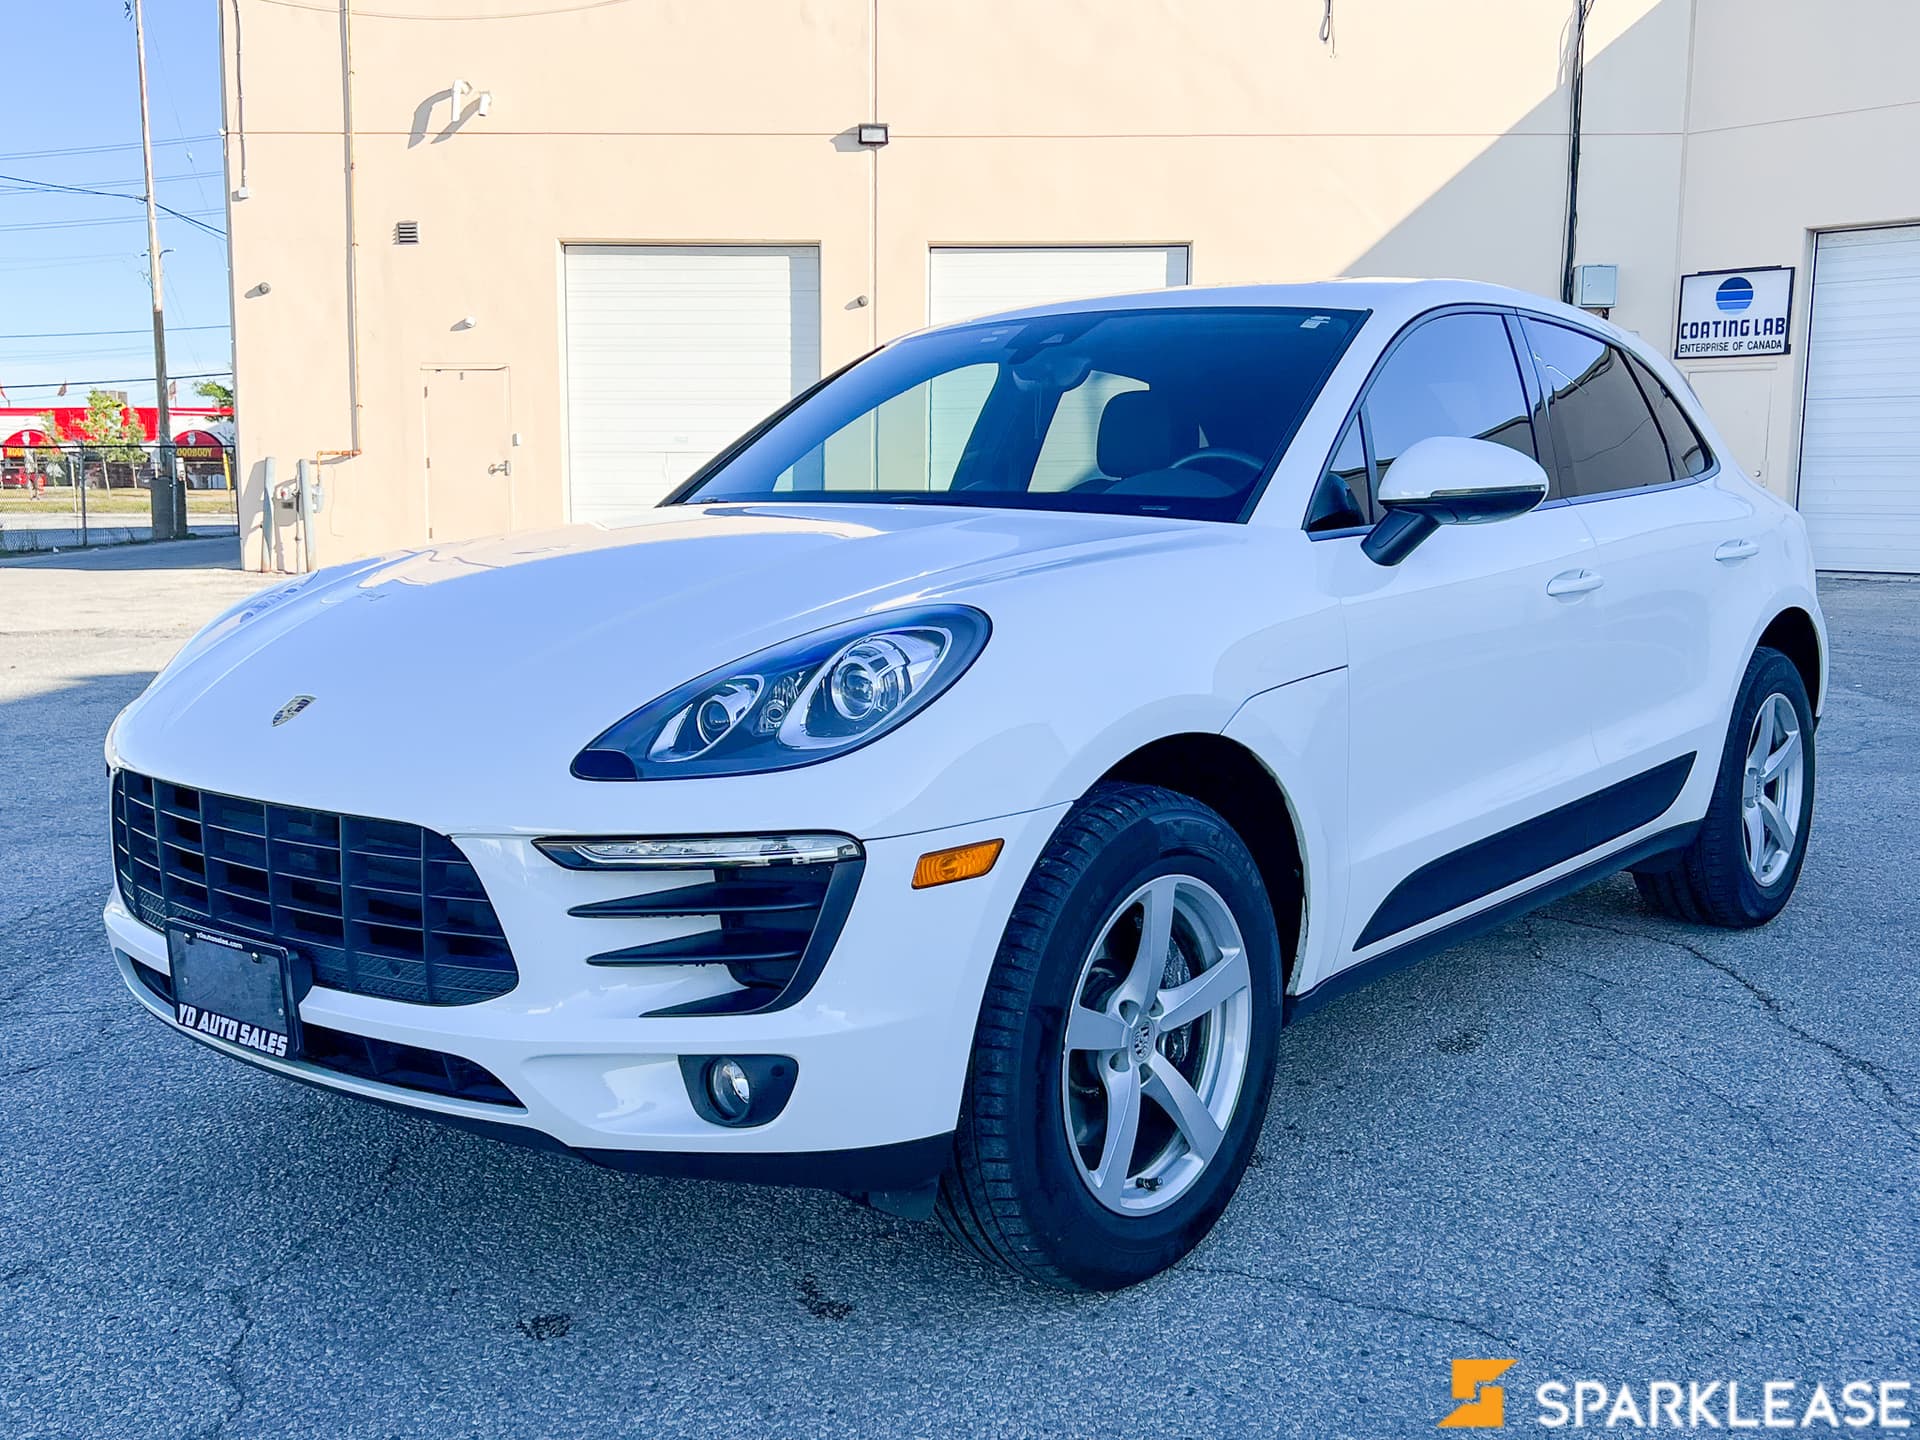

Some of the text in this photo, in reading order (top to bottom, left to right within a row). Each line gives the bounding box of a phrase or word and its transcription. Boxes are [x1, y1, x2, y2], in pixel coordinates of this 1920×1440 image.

[1681, 317, 1786, 339] COATING LAB
[1680, 340, 1782, 353] ENTERPRISE OF CANADA
[178, 1003, 288, 1057] YD AUTO SALES
